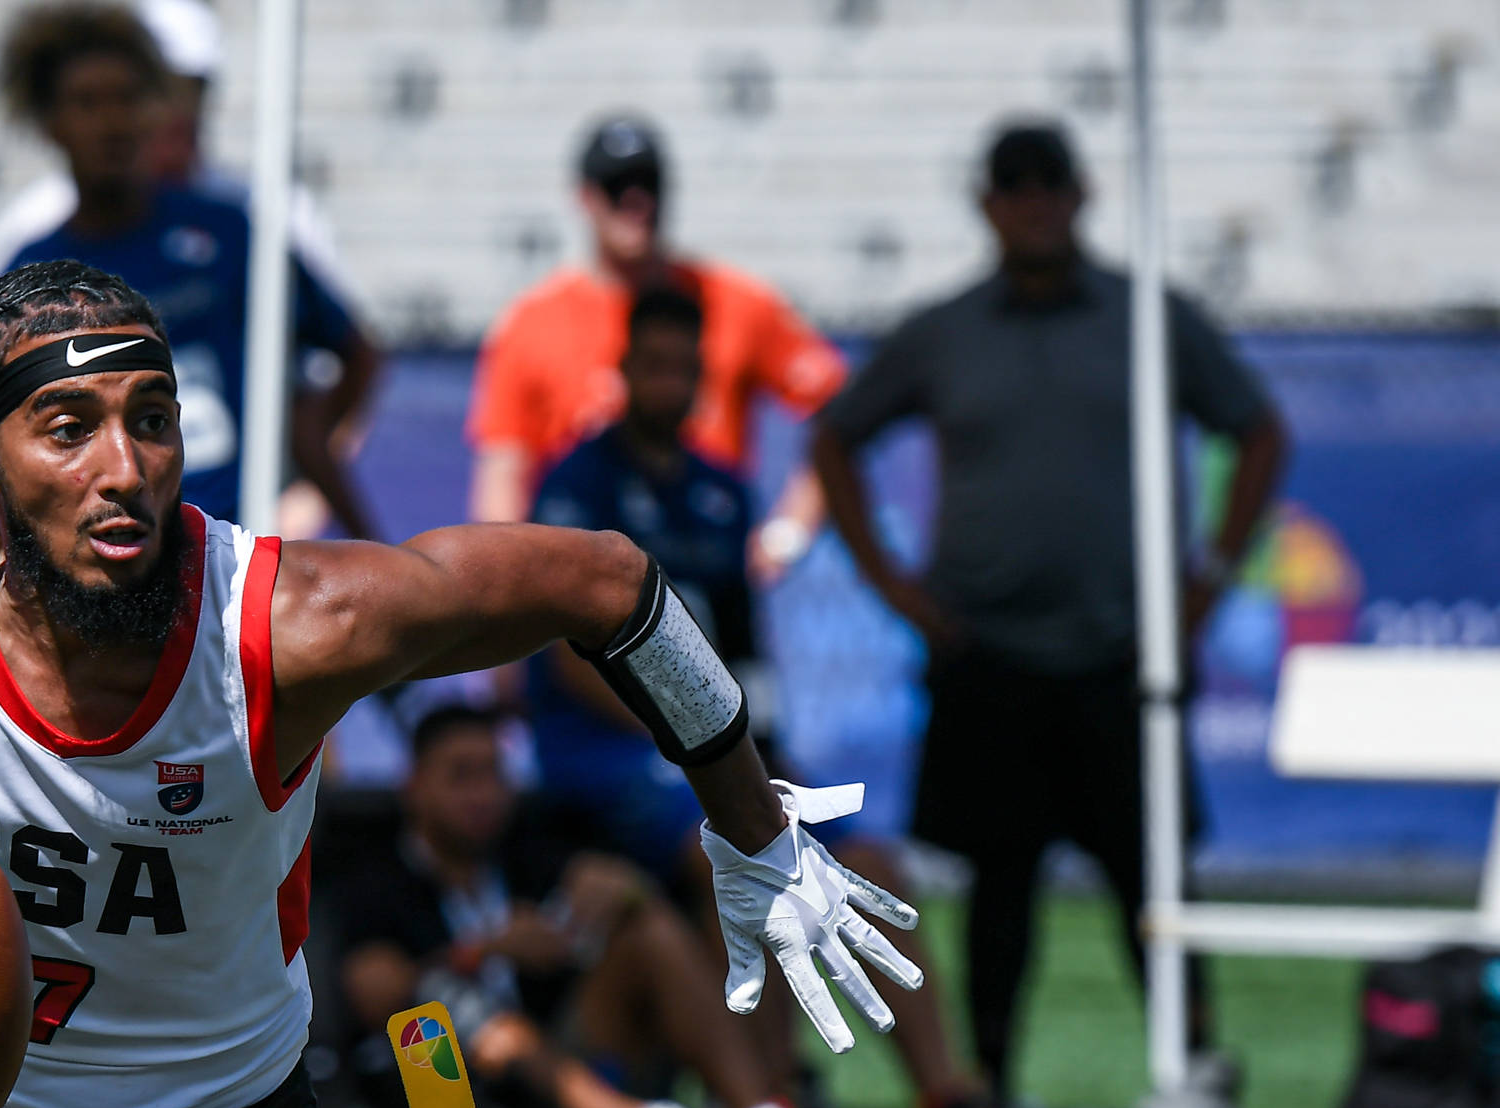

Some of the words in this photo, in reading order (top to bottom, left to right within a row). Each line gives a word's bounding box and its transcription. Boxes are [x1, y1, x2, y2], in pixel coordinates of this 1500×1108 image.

[163, 765, 199, 776] USA
[155, 815, 234, 828] NATIONAL
[157, 827, 204, 836] TEAM
